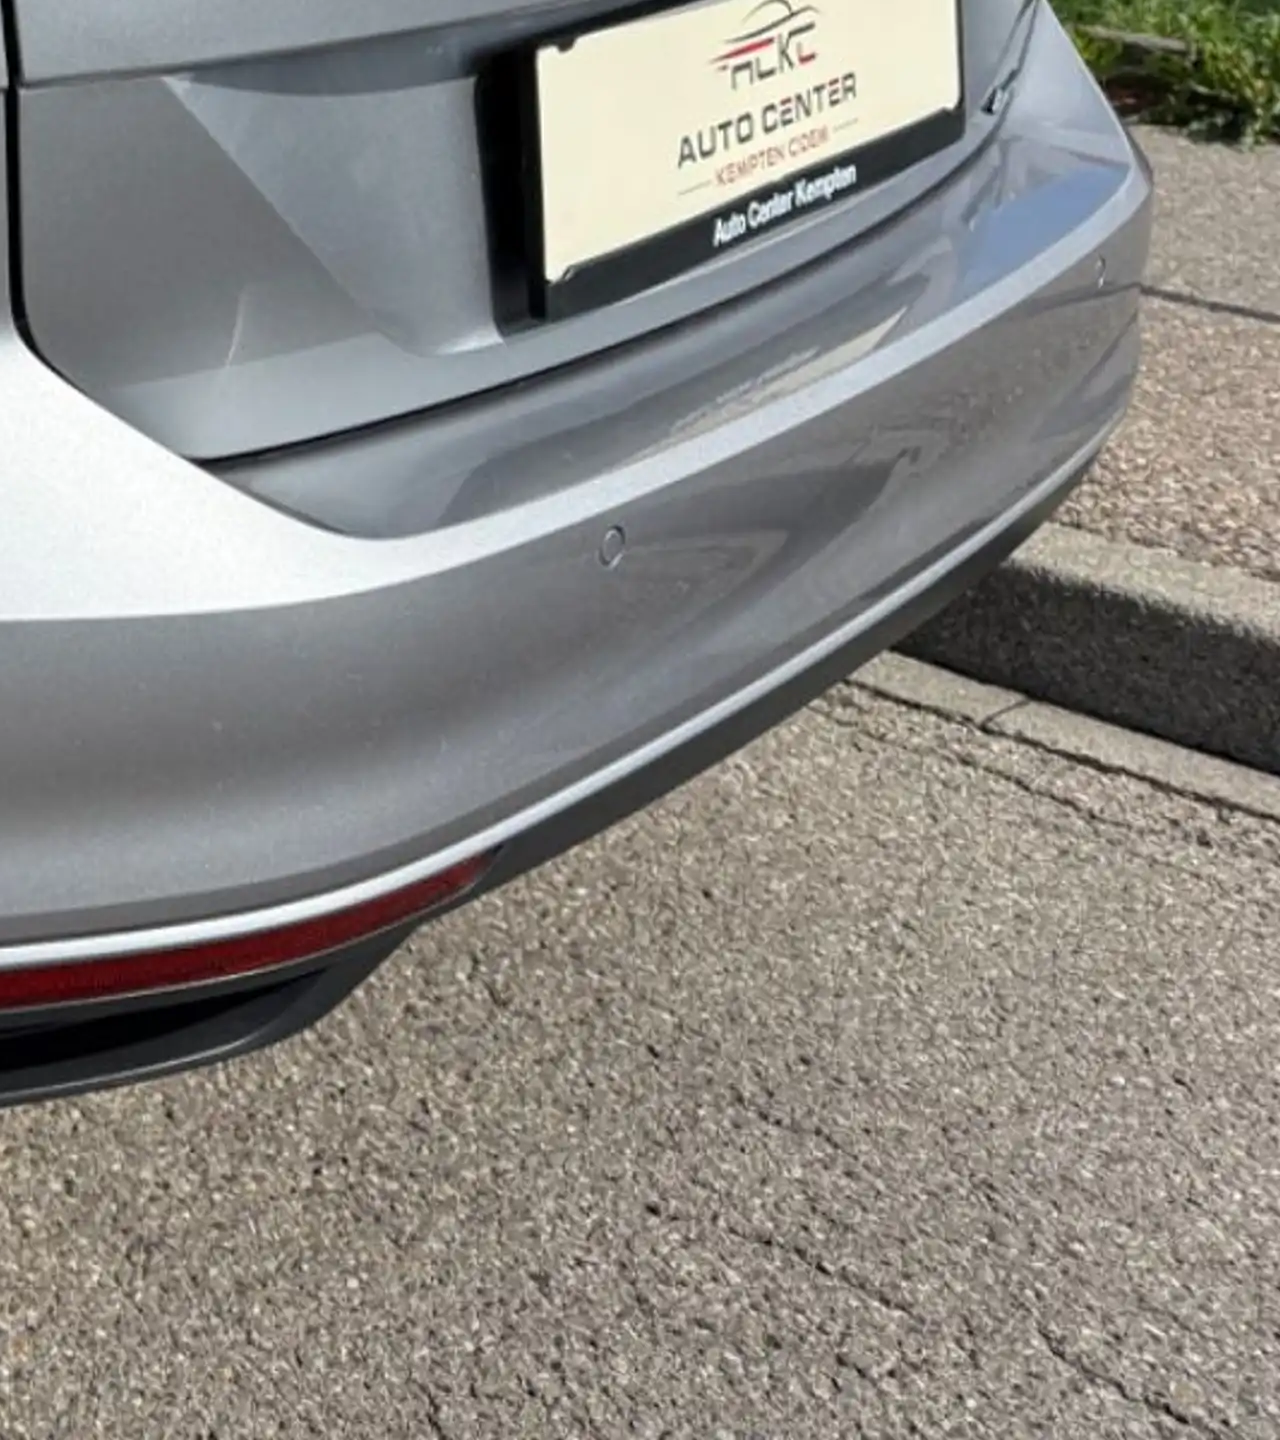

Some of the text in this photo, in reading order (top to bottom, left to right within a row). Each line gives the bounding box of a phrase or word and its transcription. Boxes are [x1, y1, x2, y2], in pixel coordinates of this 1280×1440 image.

[677, 71, 858, 168] AUTO CENTER
[713, 164, 858, 248] Auto Center Kempten
[715, 144, 786, 187] KEMPTEN
